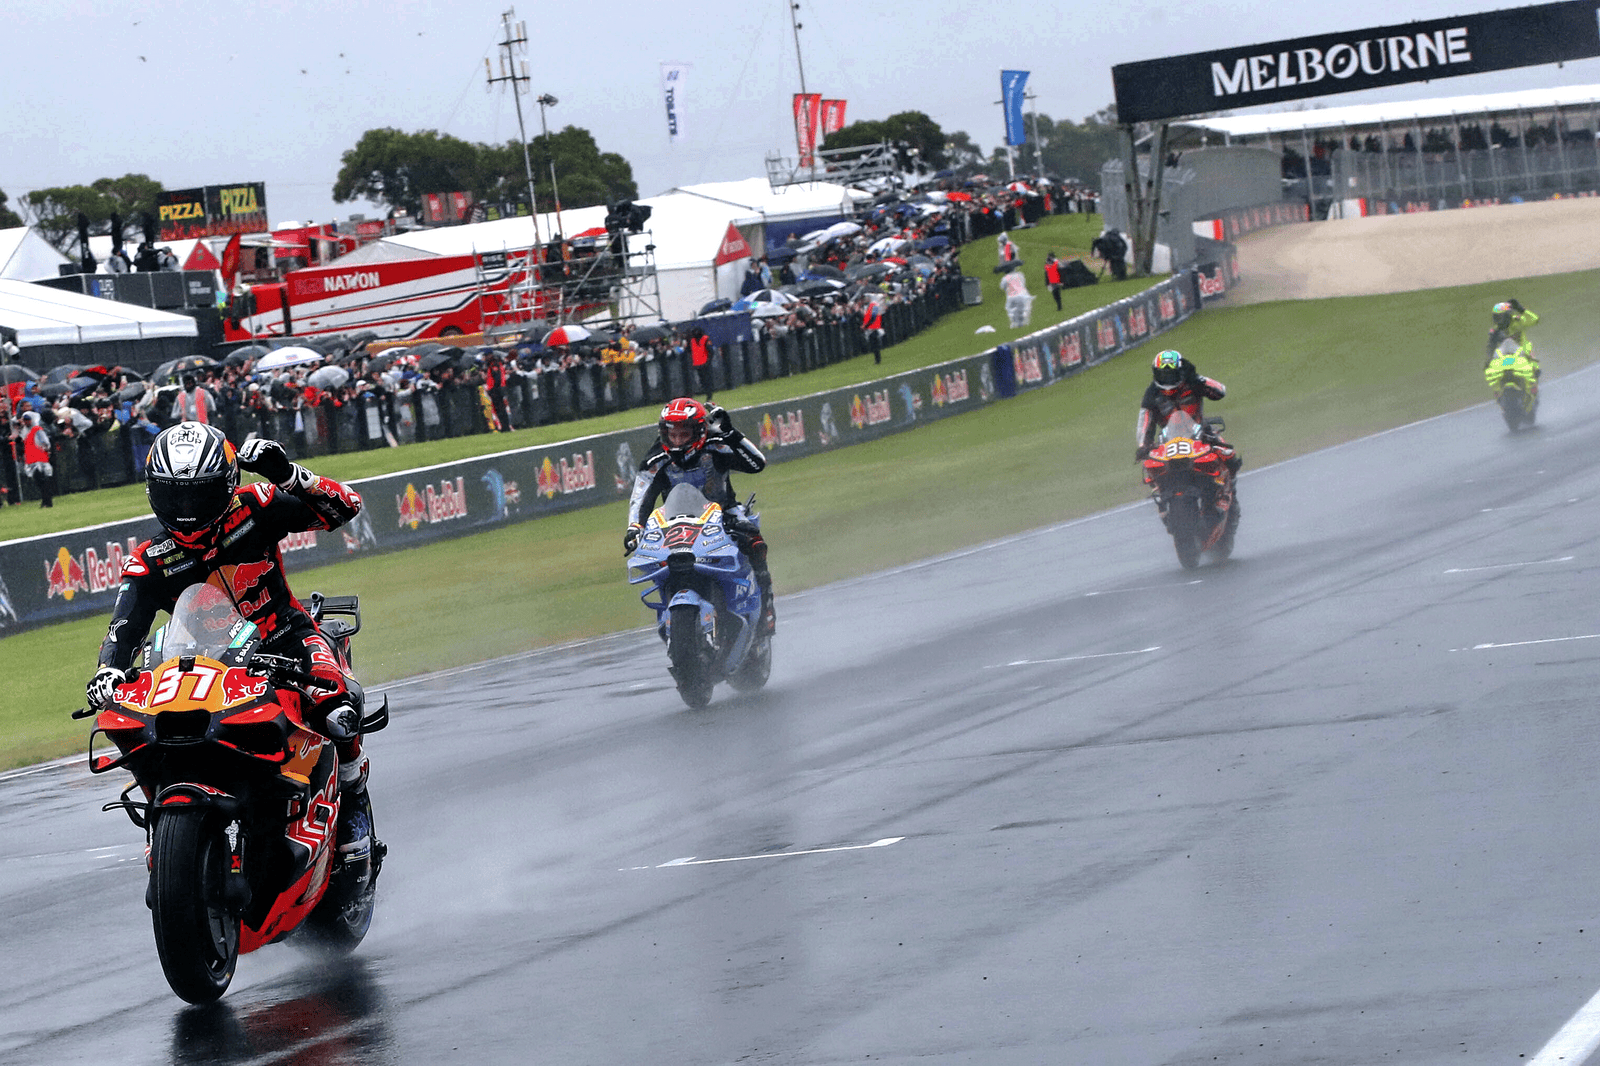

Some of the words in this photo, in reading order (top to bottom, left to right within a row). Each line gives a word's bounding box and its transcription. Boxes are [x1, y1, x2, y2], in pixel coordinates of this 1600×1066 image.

[1210, 27, 1472, 97] MELBOURNE
[159, 202, 205, 221] PIZZA
[220, 187, 258, 215] PIZZA
[1166, 443, 1194, 458] 33
[661, 525, 703, 549] 27
[238, 586, 272, 619] Bull
[150, 664, 224, 709] 37
